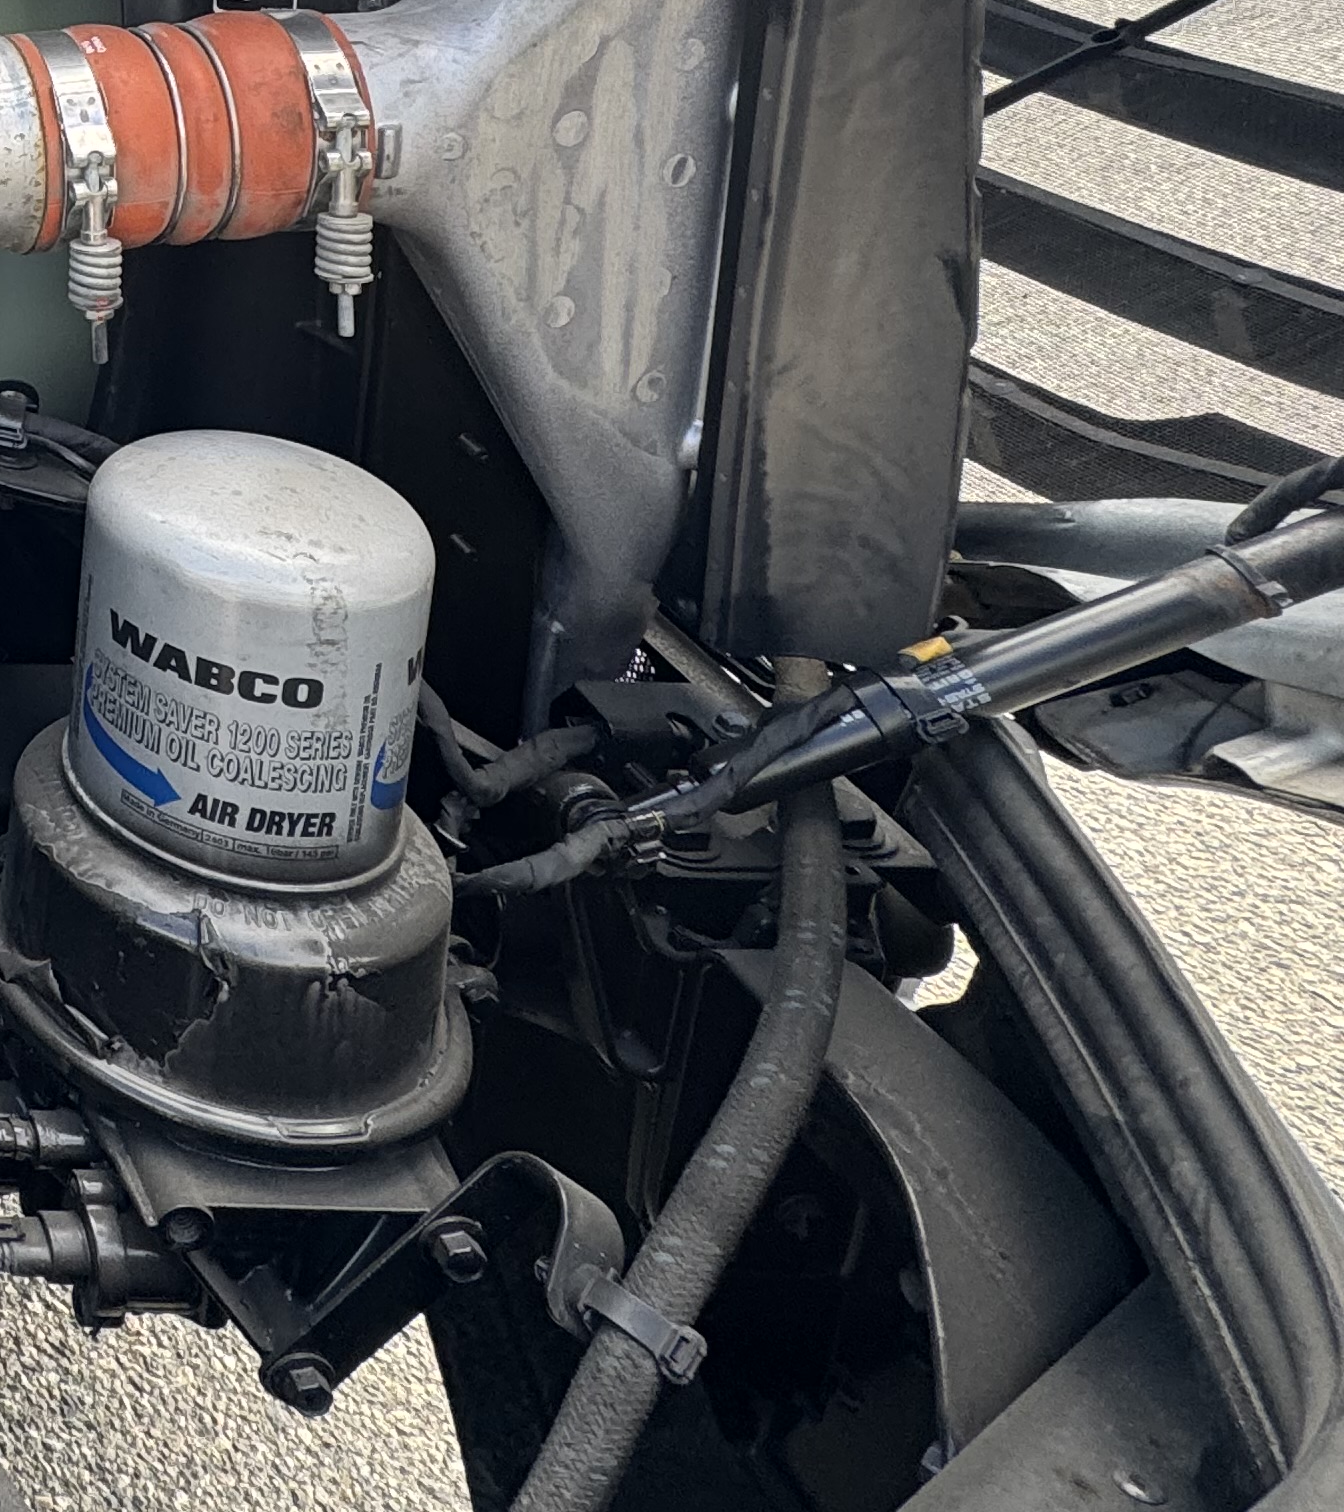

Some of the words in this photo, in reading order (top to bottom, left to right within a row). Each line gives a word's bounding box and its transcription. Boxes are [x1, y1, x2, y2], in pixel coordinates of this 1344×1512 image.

[110, 608, 324, 709] WABCO
[91, 683, 162, 757] PREMIUM
[165, 731, 200, 772] OIL
[206, 748, 347, 793] COALESCING
[93, 648, 151, 716] SYSTEM
[153, 693, 220, 745] SAVER
[228, 720, 281, 758] 1200
[285, 730, 353, 761] SERIES
[124, 793, 145, 813] Made
[146, 808, 156, 818] in
[157, 813, 201, 838] Germany
[187, 793, 240, 828] AIR
[245, 807, 336, 837] DRYER
[192, 891, 229, 919] DO
[243, 904, 292, 931] NOT
